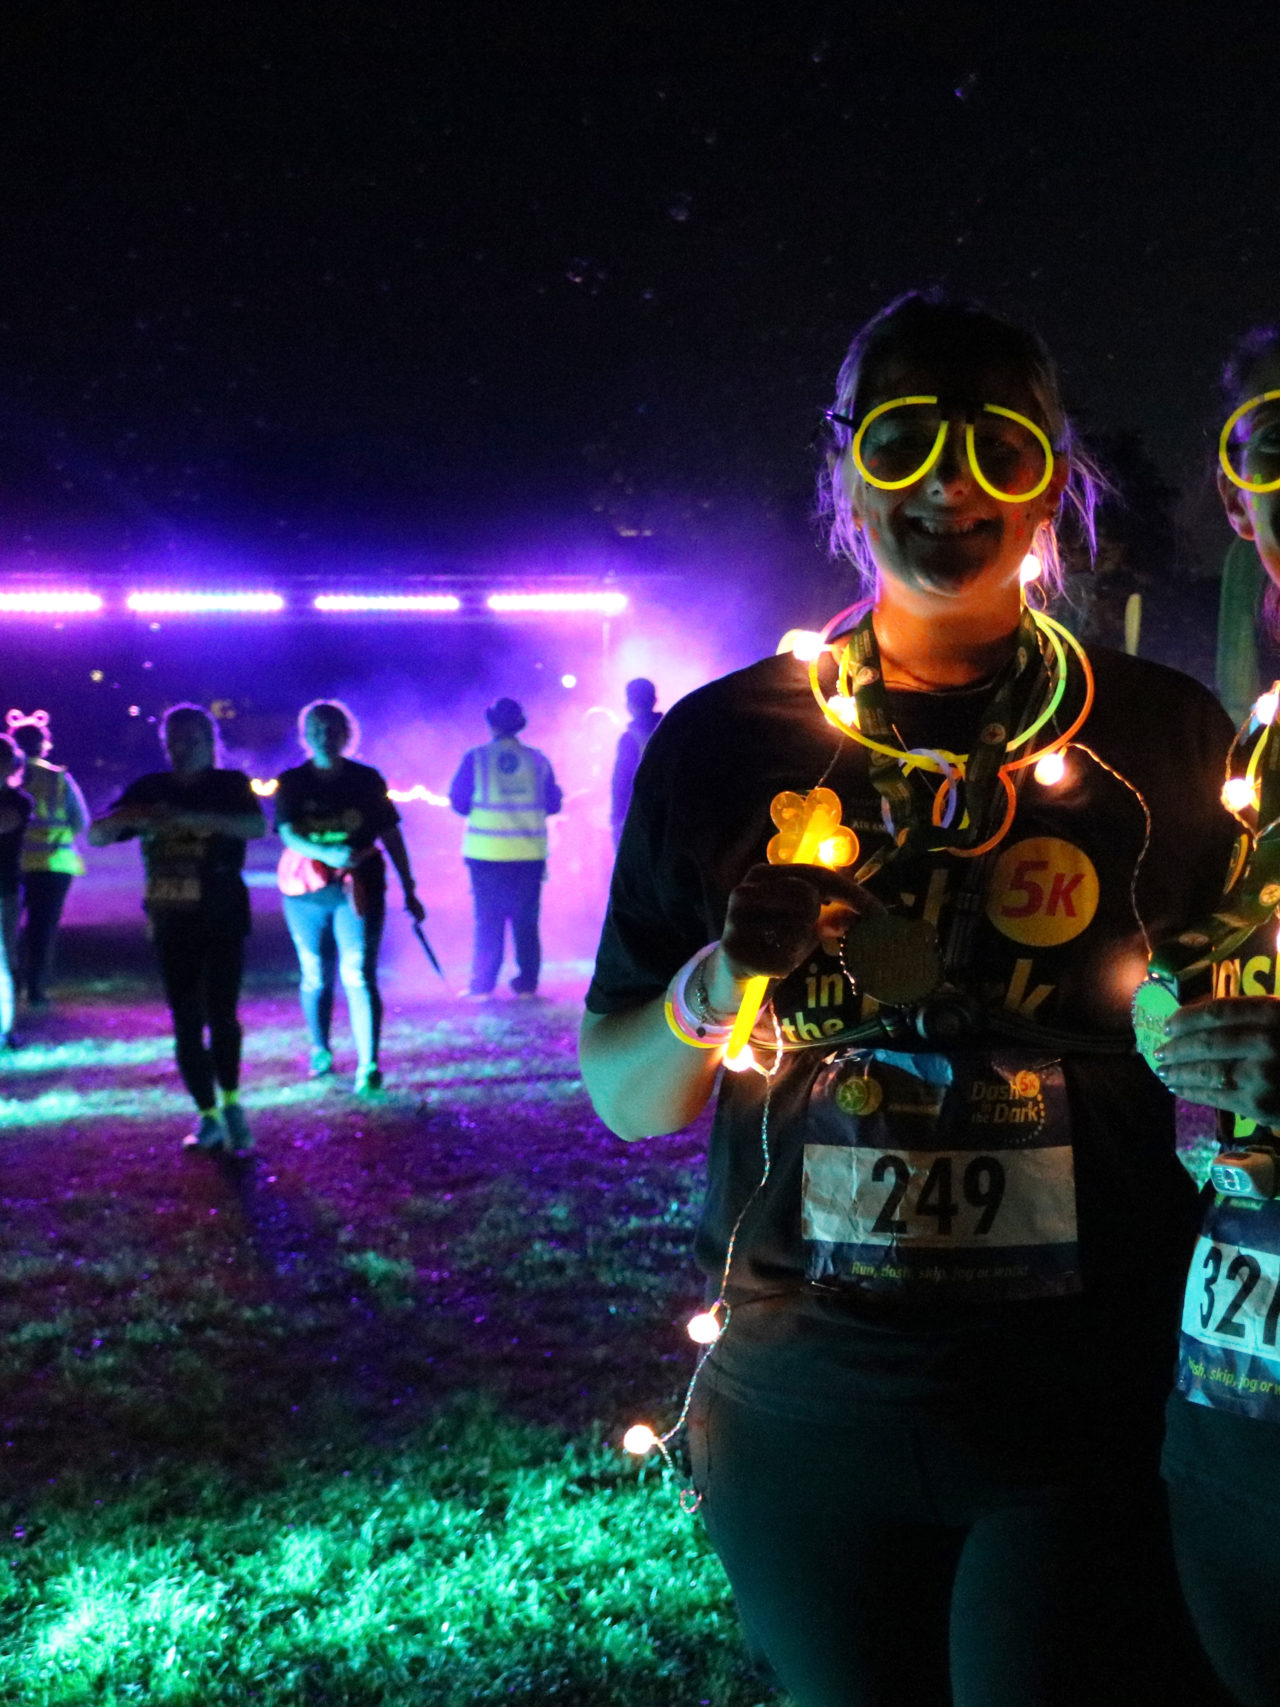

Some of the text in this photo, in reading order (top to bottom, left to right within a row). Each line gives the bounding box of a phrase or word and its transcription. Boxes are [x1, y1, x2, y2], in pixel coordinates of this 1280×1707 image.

[1001, 860, 1086, 920] 5K
[806, 967, 844, 1009] in
[781, 1012, 844, 1043] the
[971, 1080, 1020, 1102] Dash
[1021, 1076, 1037, 1092] 5K
[993, 1101, 1039, 1124] Dark
[871, 1156, 1006, 1235] 249
[1210, 1367, 1237, 1387] skip,
[1238, 1374, 1258, 1393] jog
[1260, 1381, 1274, 1393] or
